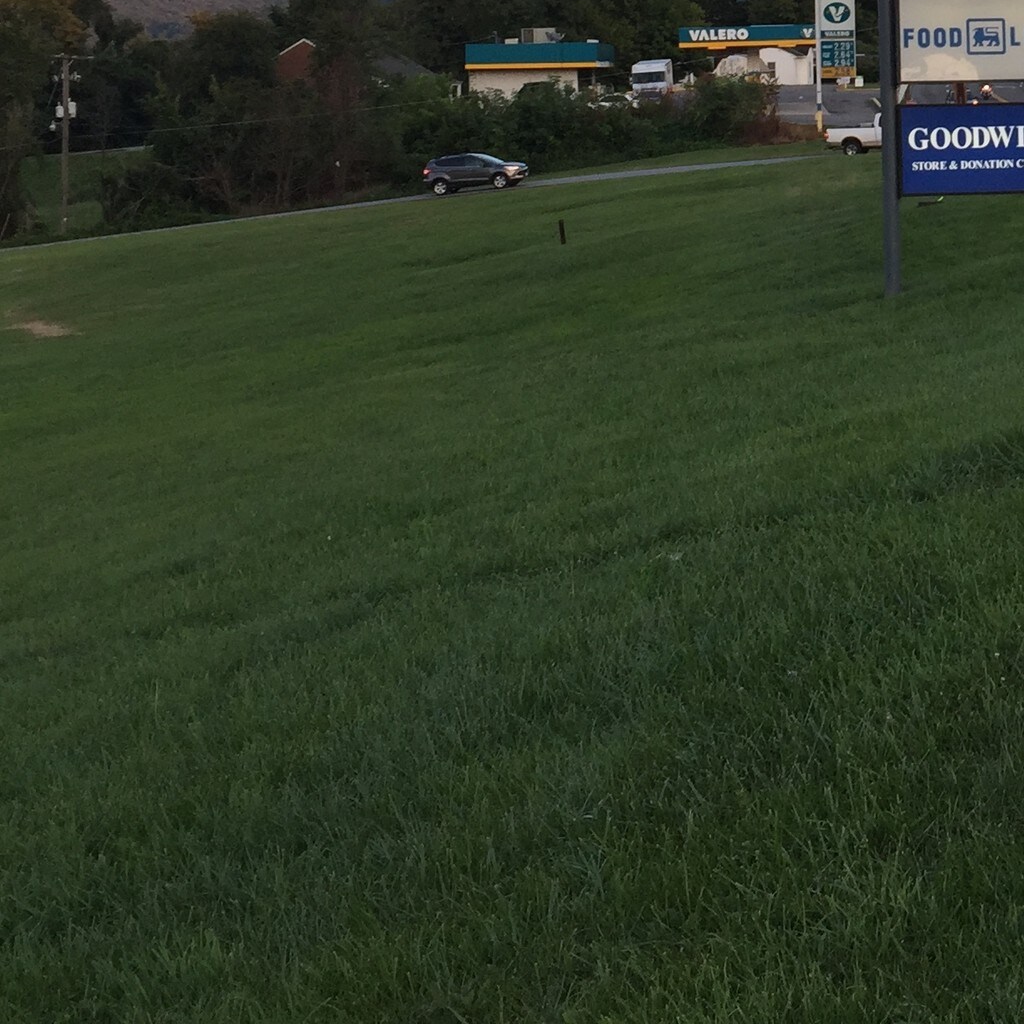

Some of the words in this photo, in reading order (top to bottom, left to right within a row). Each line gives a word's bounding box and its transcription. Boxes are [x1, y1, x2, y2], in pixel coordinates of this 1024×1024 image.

[689, 28, 750, 41] VALERO
[903, 27, 962, 48] FOOD
[911, 160, 947, 171] STORE
[949, 160, 958, 170] &
[960, 159, 1014, 170] DONATION
